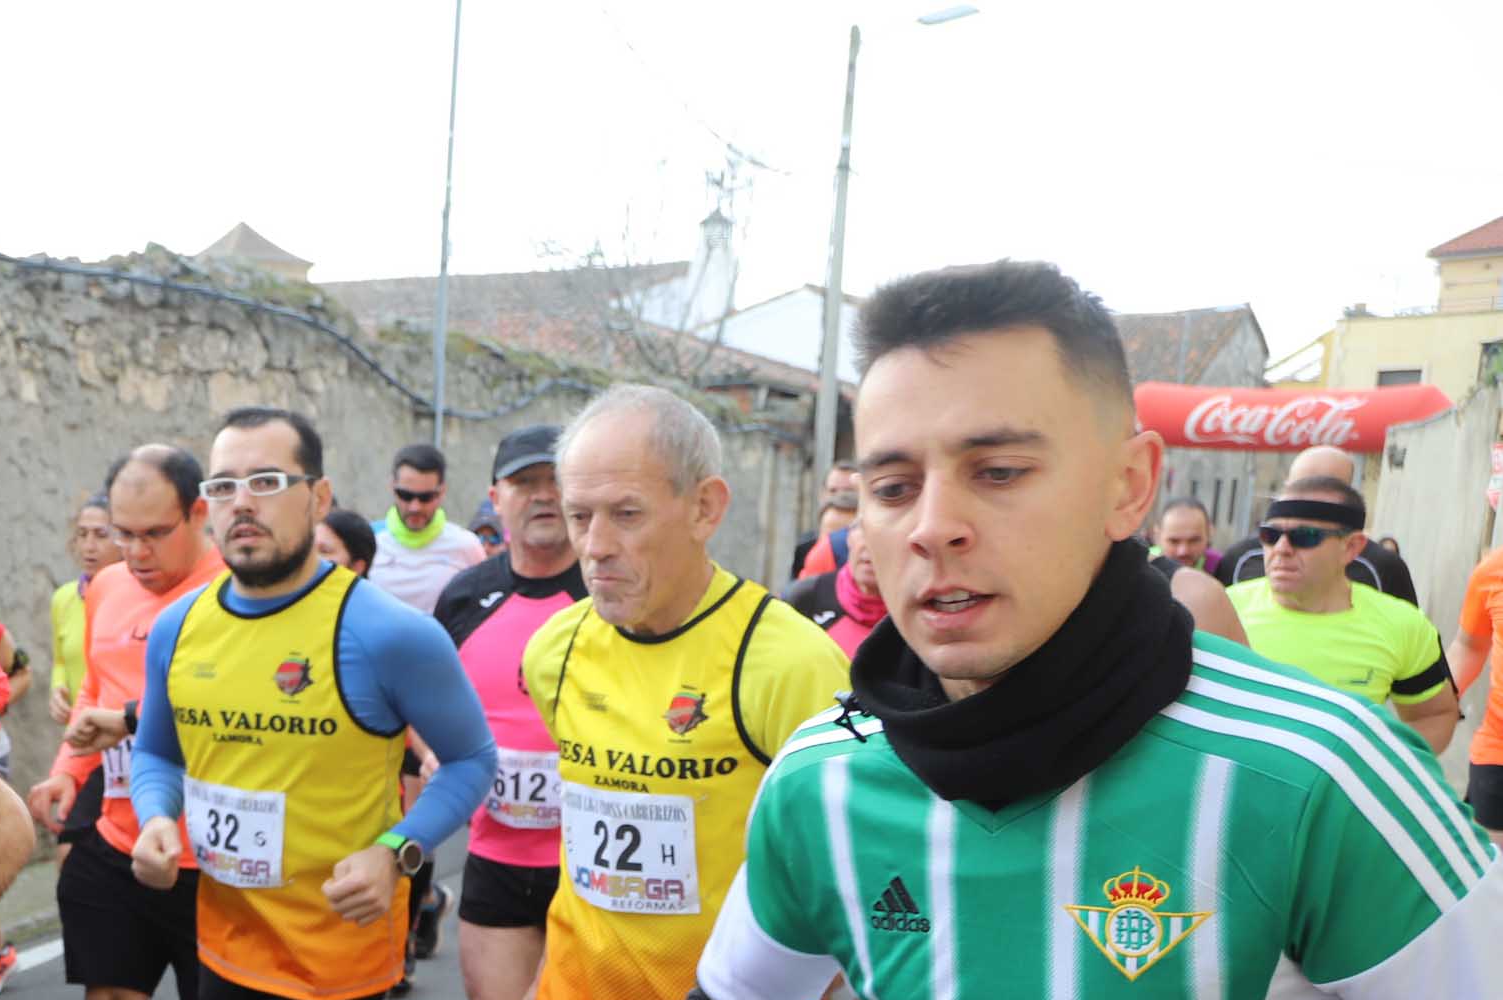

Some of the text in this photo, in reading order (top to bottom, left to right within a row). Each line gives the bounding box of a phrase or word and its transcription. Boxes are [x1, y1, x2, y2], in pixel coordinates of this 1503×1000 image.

[220, 709, 338, 735] VALORIO
[606, 749, 738, 780] VALORIO
[493, 769, 547, 802] 612
[594, 775, 650, 794] ZAMORA
[206, 808, 240, 852] 32
[593, 820, 643, 872] 22
[661, 843, 676, 865] H
[871, 914, 931, 933] adidas
